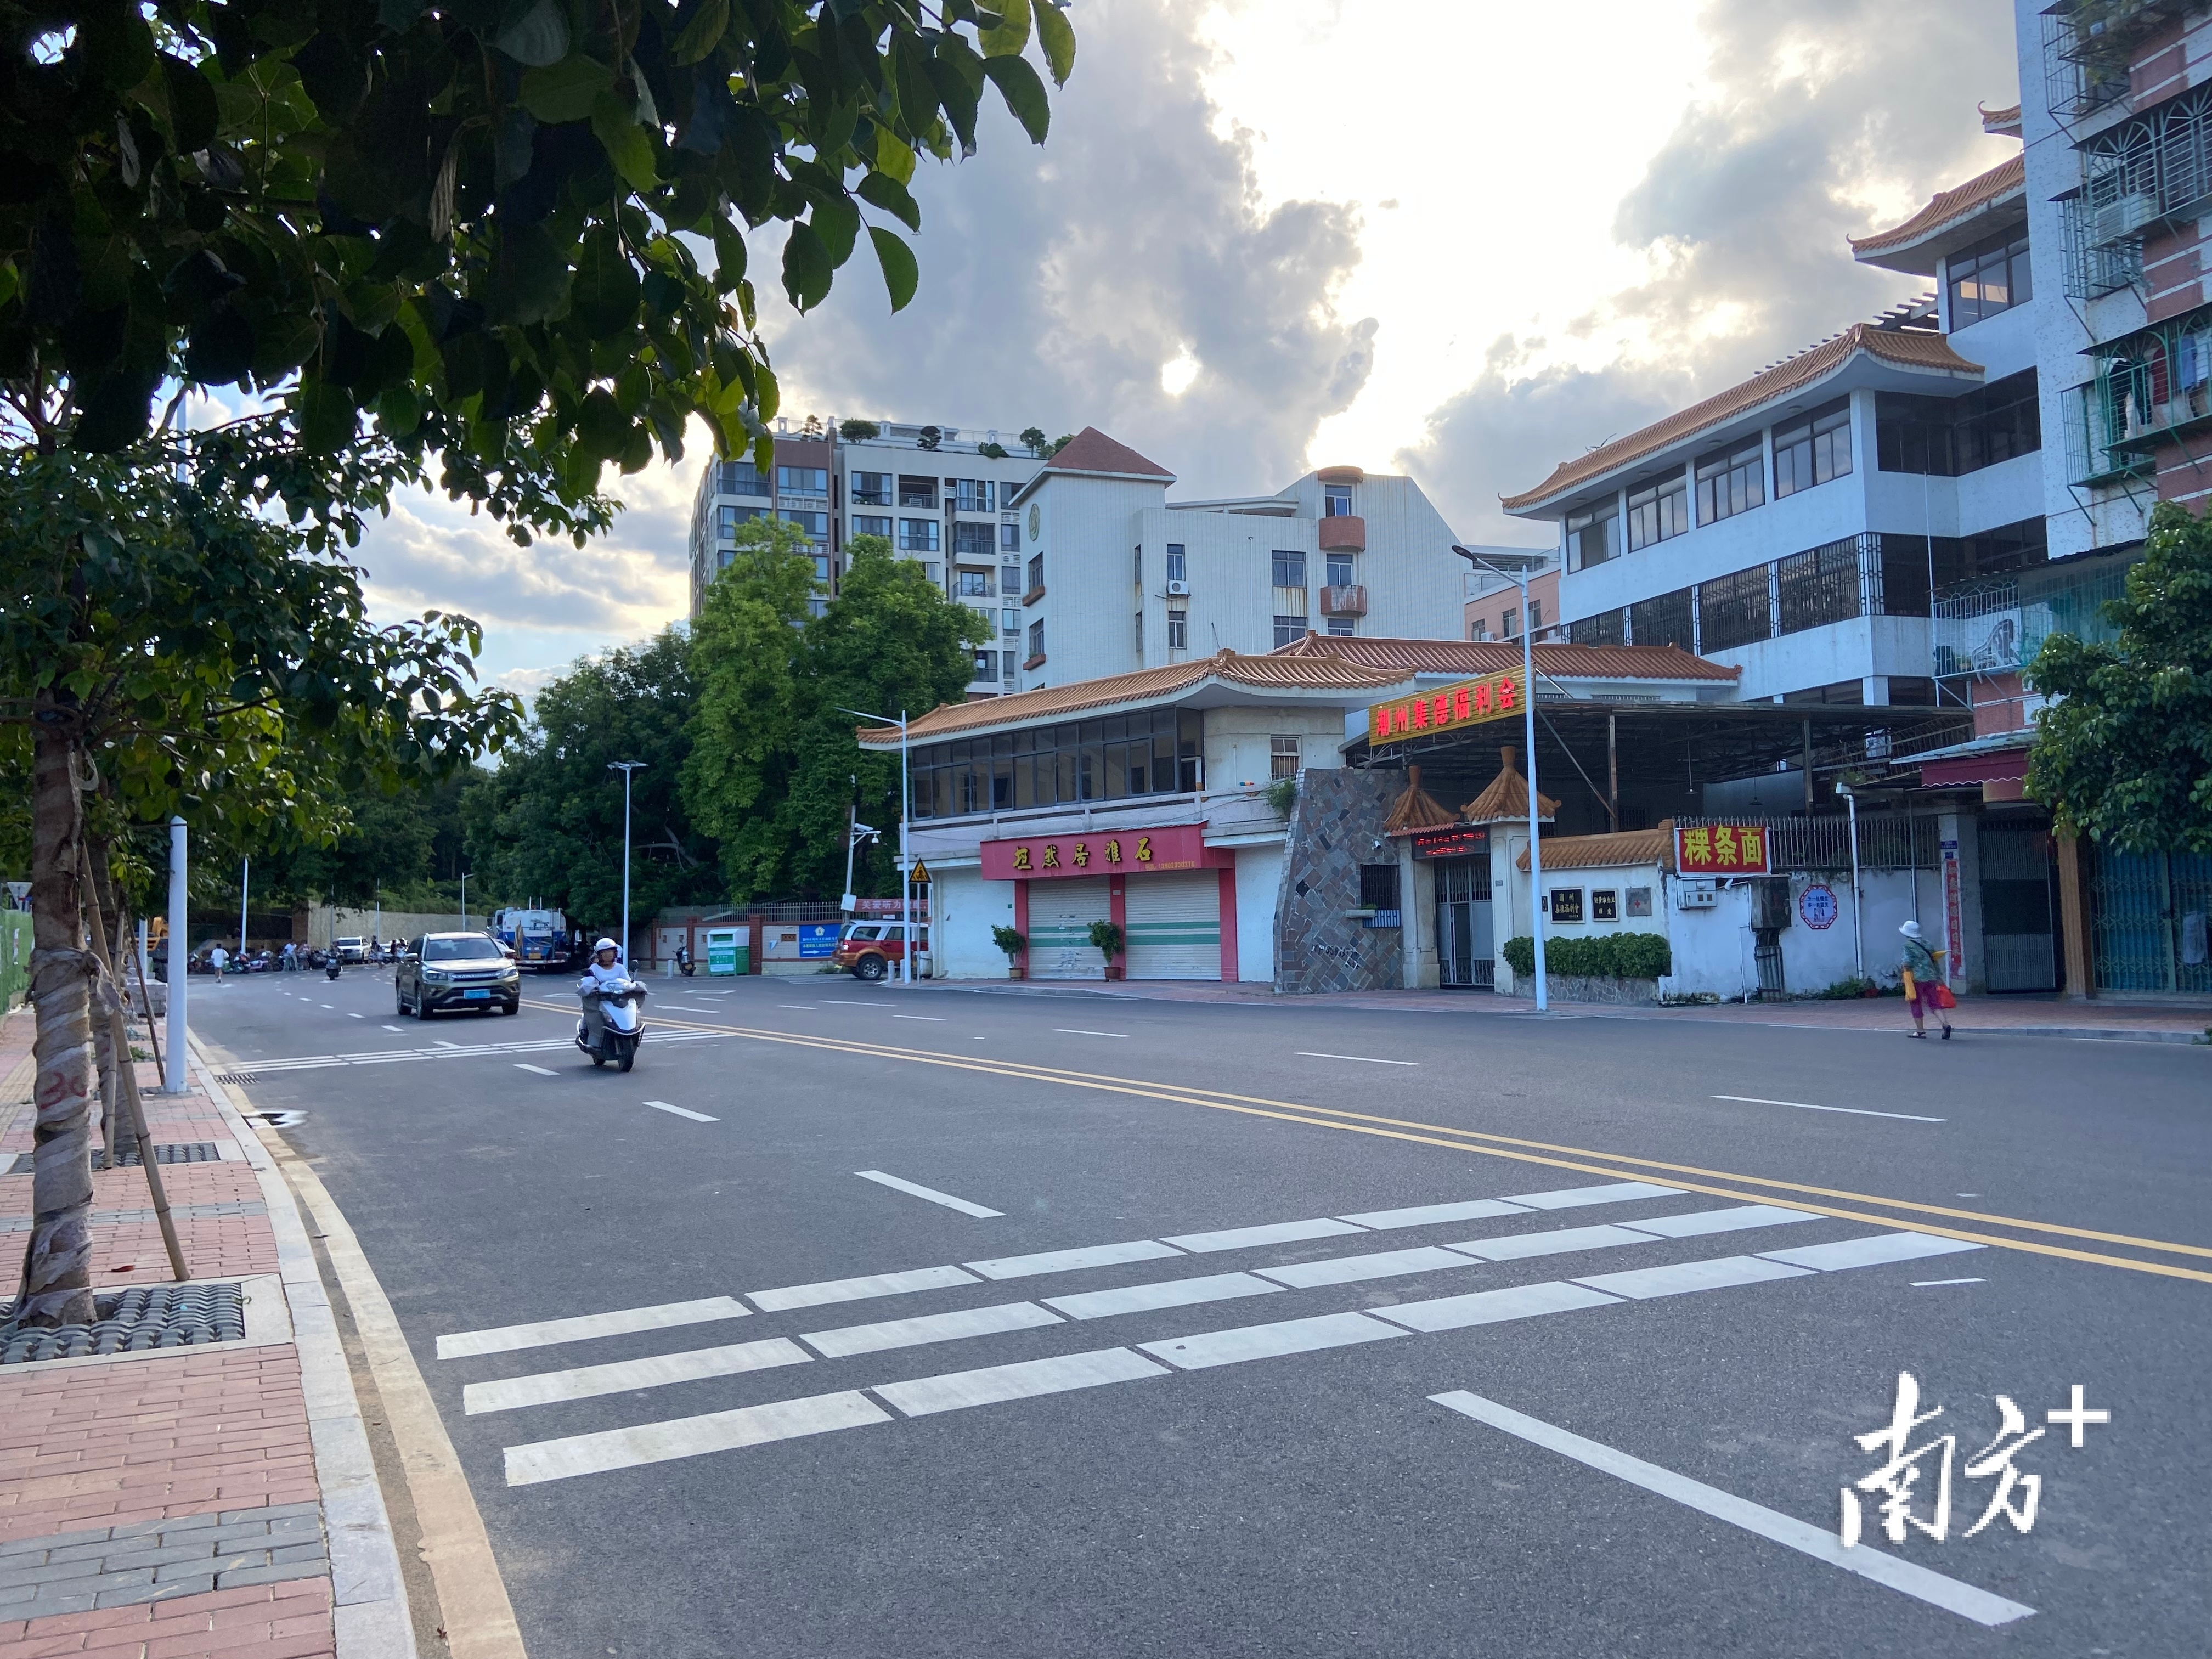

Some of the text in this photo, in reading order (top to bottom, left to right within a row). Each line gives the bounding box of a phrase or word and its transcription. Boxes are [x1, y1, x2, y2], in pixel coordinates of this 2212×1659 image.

[1376, 676, 1516, 737] 潮州集德福利会
[1684, 825, 1762, 866] 粿条面
